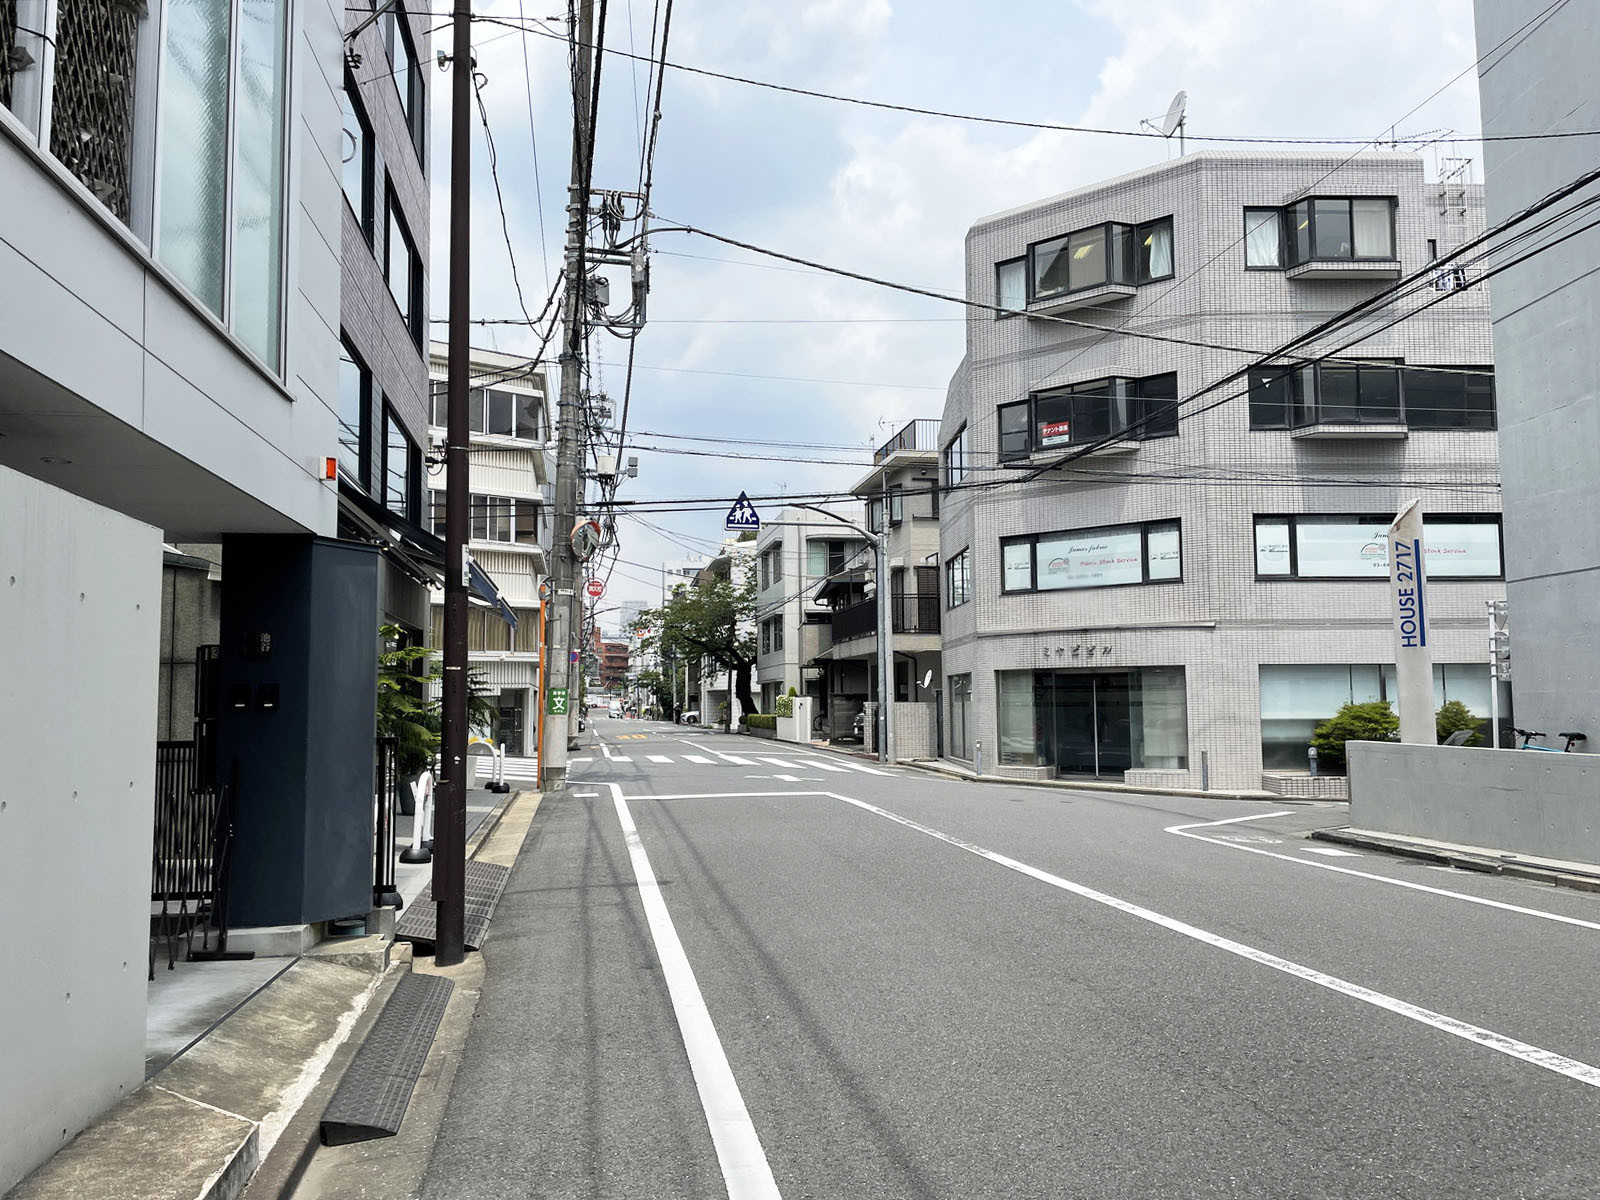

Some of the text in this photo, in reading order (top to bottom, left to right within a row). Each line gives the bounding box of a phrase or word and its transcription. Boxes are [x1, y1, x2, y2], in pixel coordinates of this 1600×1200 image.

[1068, 546, 1087, 554] James
[1099, 558, 1115, 566] Stock
[1395, 541, 1418, 648] HOUSE 2717
[552, 696, 566, 710] 文
